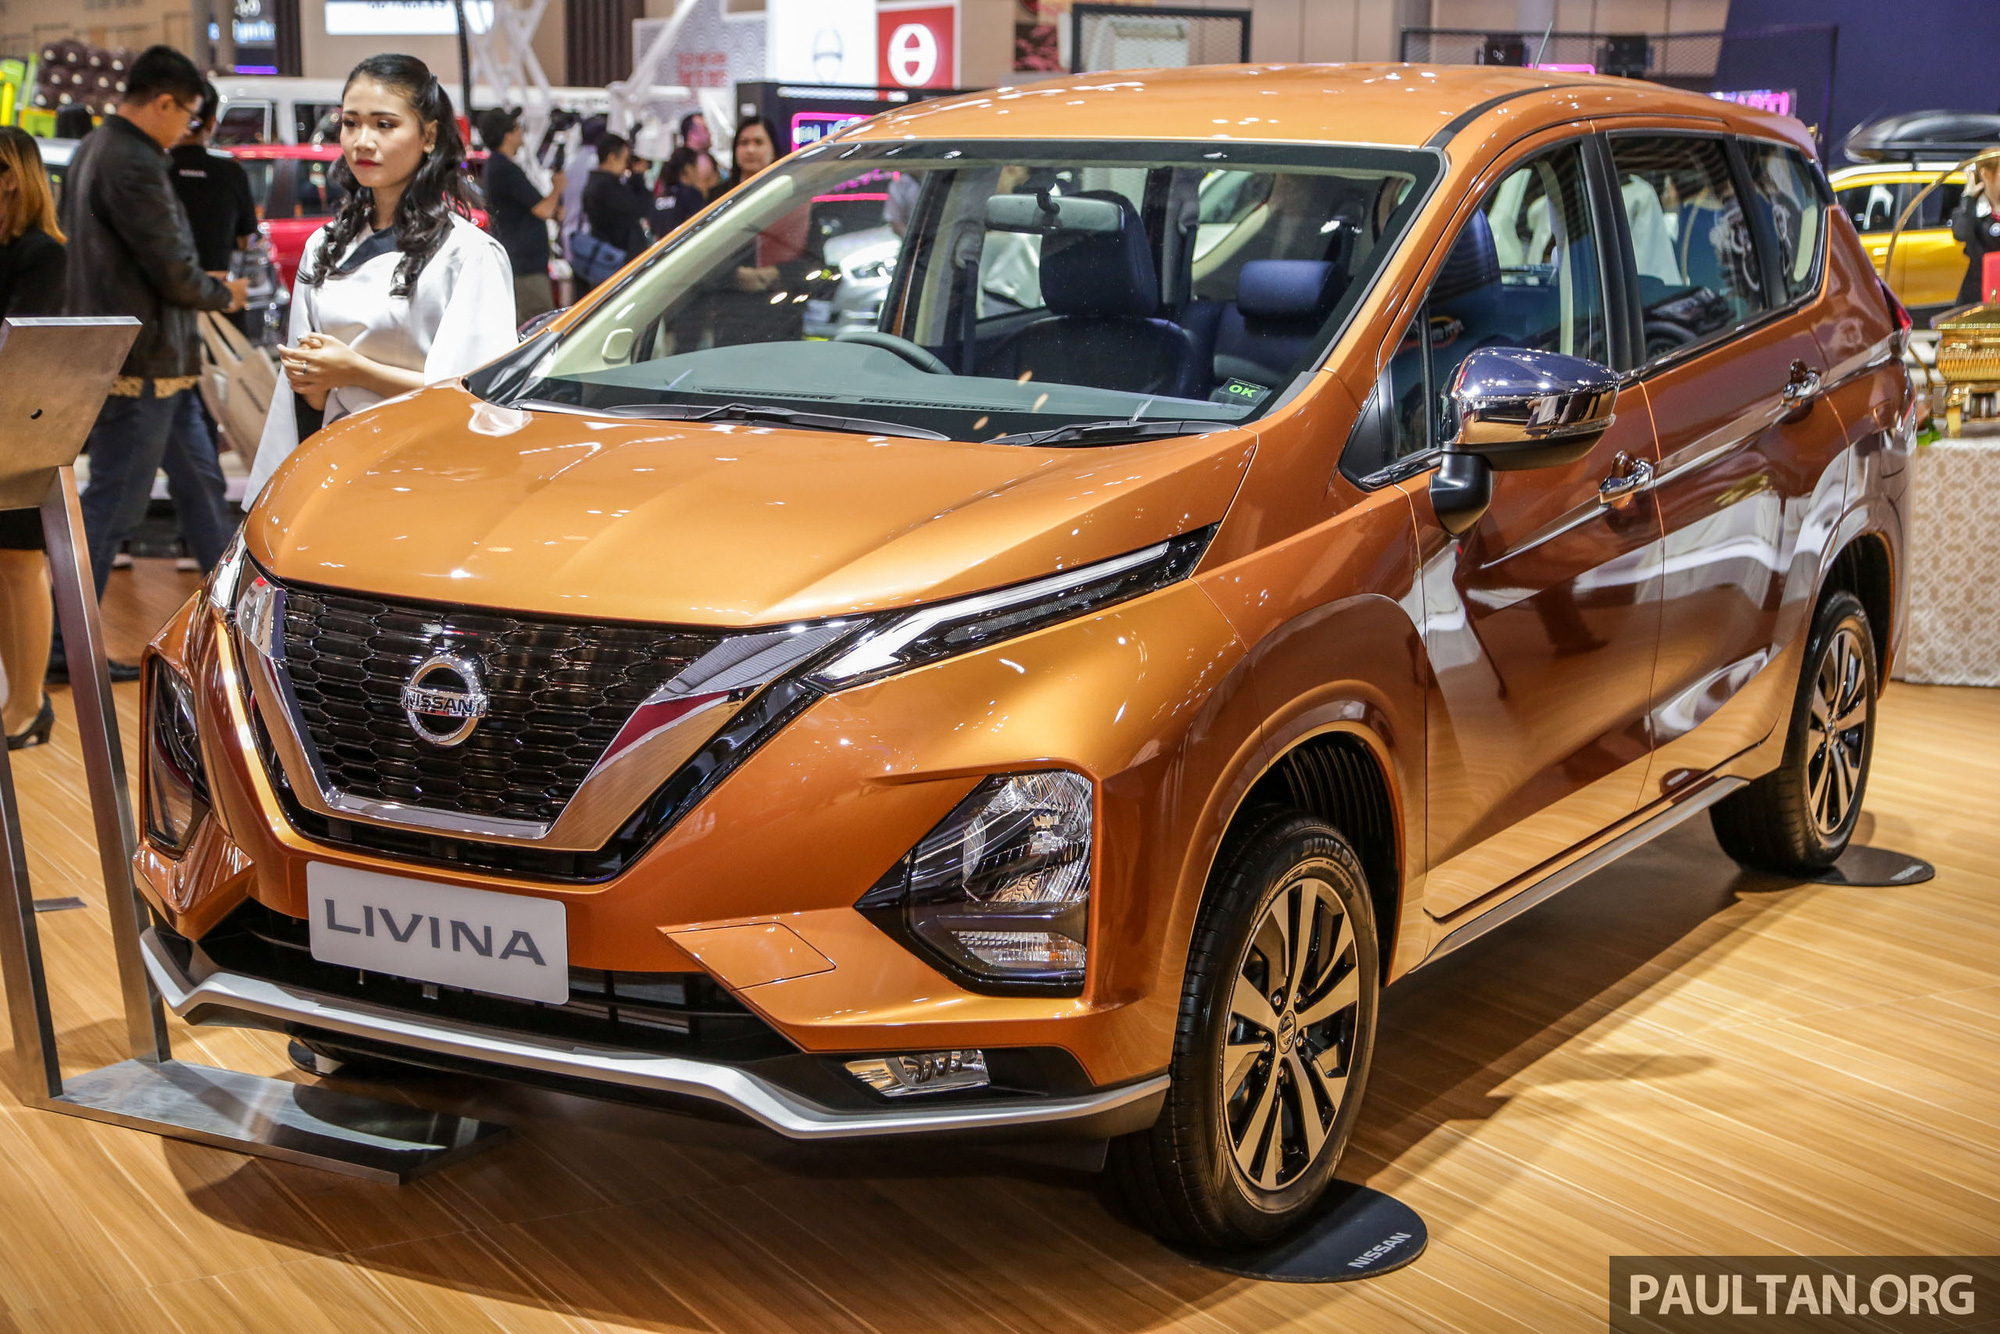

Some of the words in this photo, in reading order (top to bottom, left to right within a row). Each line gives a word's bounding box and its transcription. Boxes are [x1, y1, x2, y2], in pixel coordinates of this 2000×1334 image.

[1229, 384, 1257, 398] OK
[405, 691, 473, 712] NISSAN
[1301, 837, 1359, 873] DUNLOP
[324, 898, 547, 966] LIVINA
[1347, 1232, 1412, 1268] NISSAN
